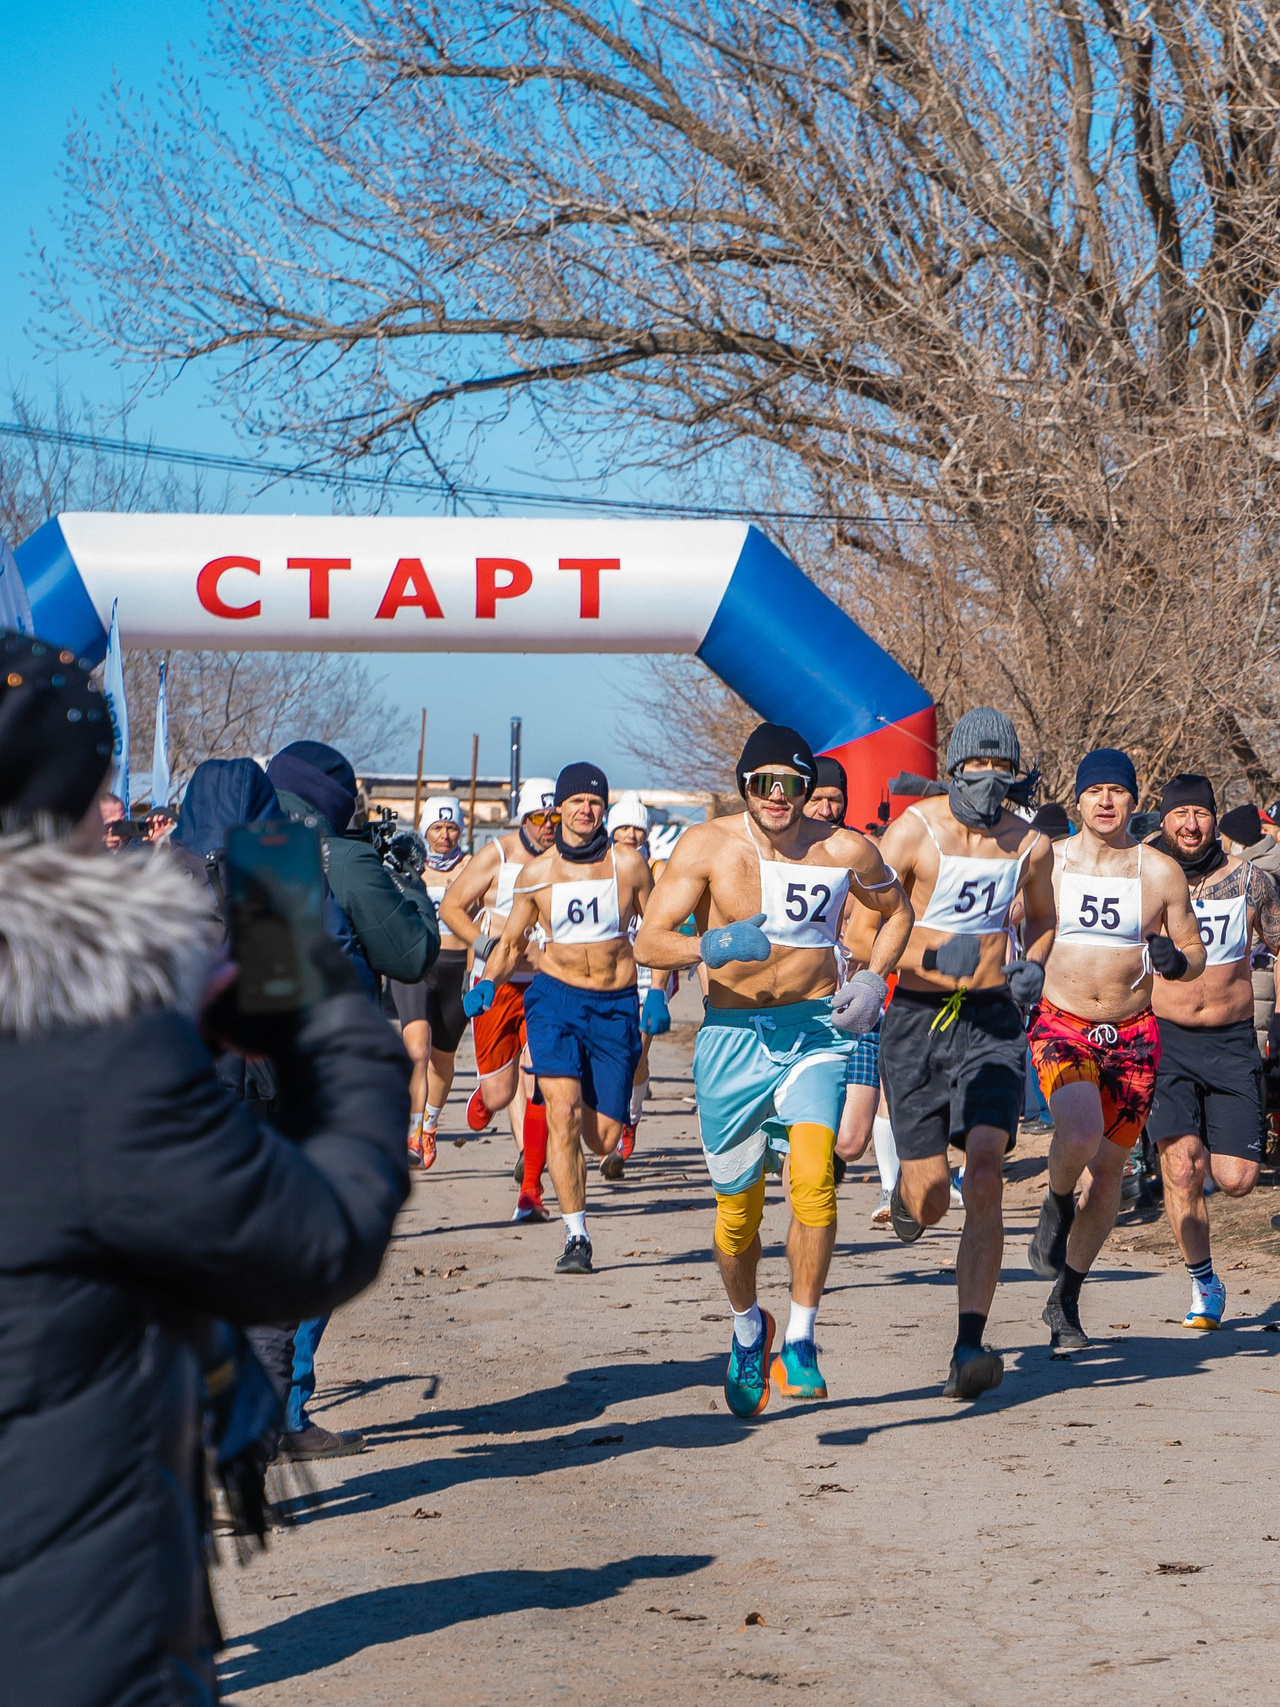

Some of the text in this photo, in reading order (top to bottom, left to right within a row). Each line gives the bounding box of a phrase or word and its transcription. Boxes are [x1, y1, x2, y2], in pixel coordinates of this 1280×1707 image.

[196, 555, 621, 620] СТАРТ
[566, 896, 599, 925] 61
[784, 883, 832, 924] 52
[953, 880, 996, 916] 51
[1078, 894, 1121, 930] 55
[1197, 914, 1231, 947] 57
